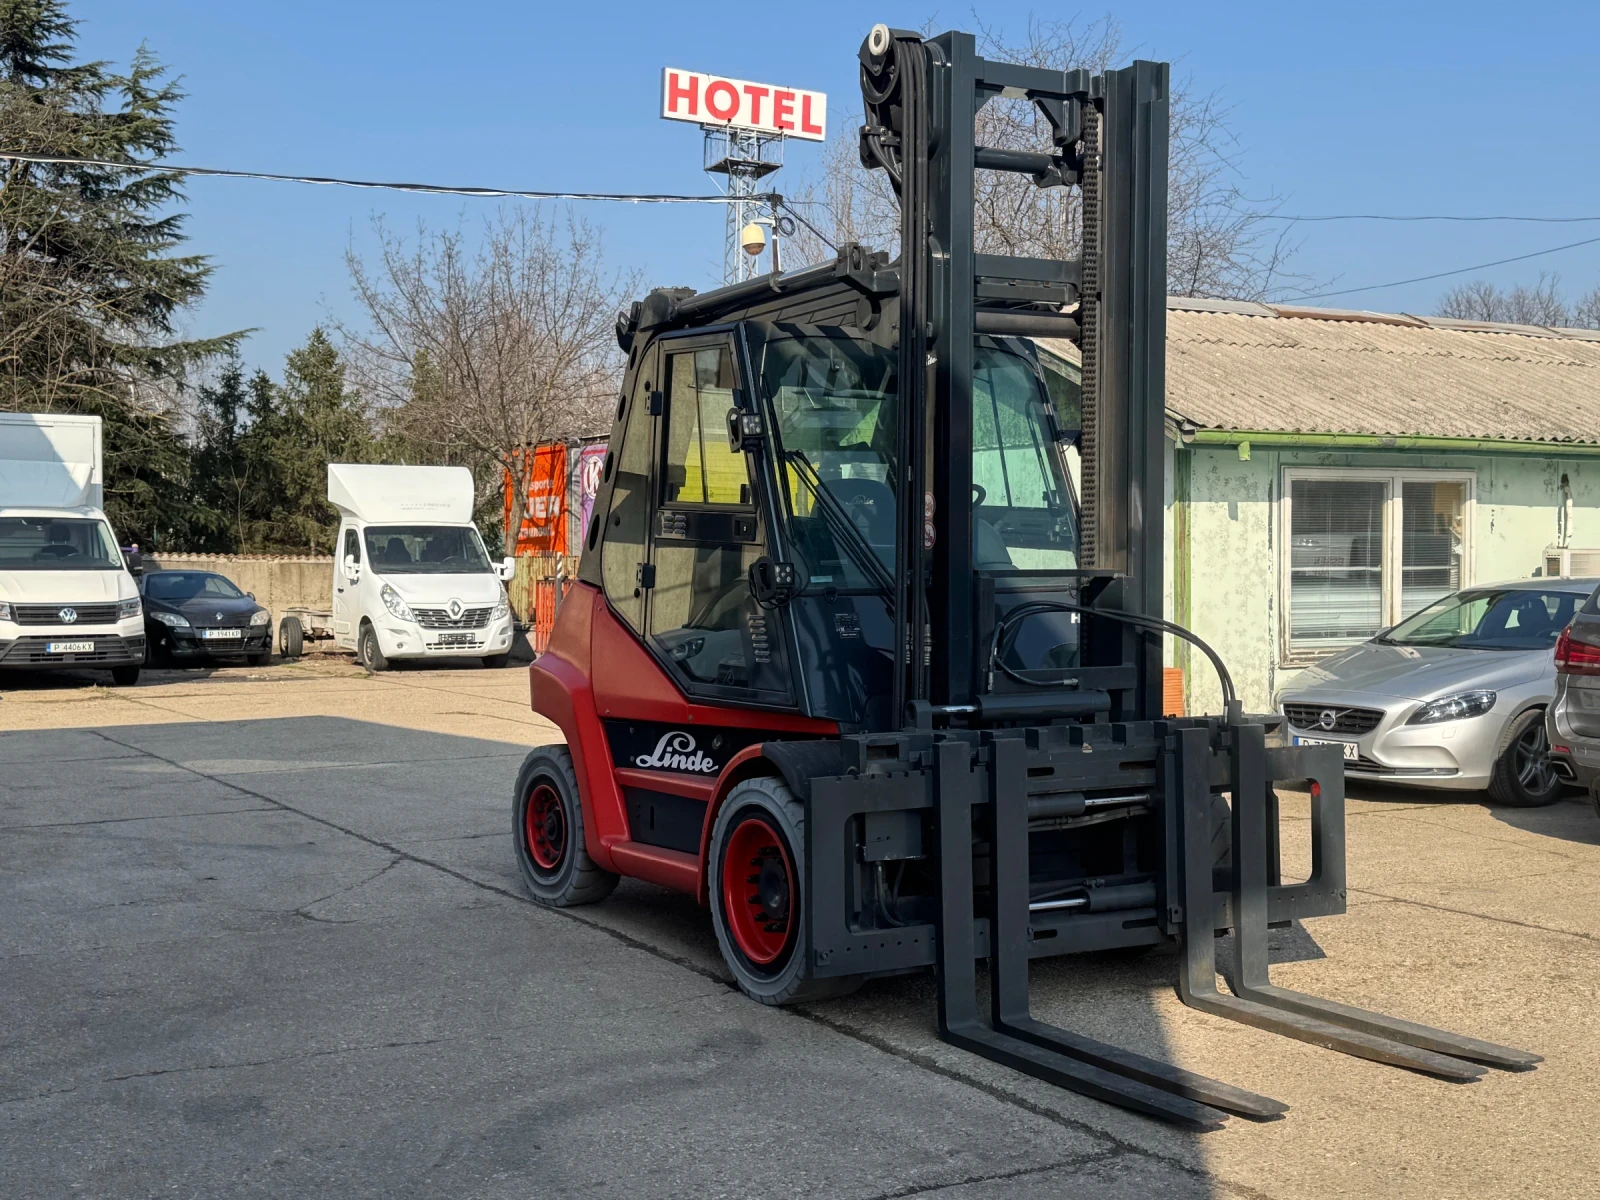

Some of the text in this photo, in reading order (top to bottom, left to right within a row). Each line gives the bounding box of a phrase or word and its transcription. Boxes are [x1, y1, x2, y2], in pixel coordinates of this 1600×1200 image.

[668, 73, 823, 135] HOTEL
[54, 643, 60, 652] P
[635, 731, 719, 773] Linde
